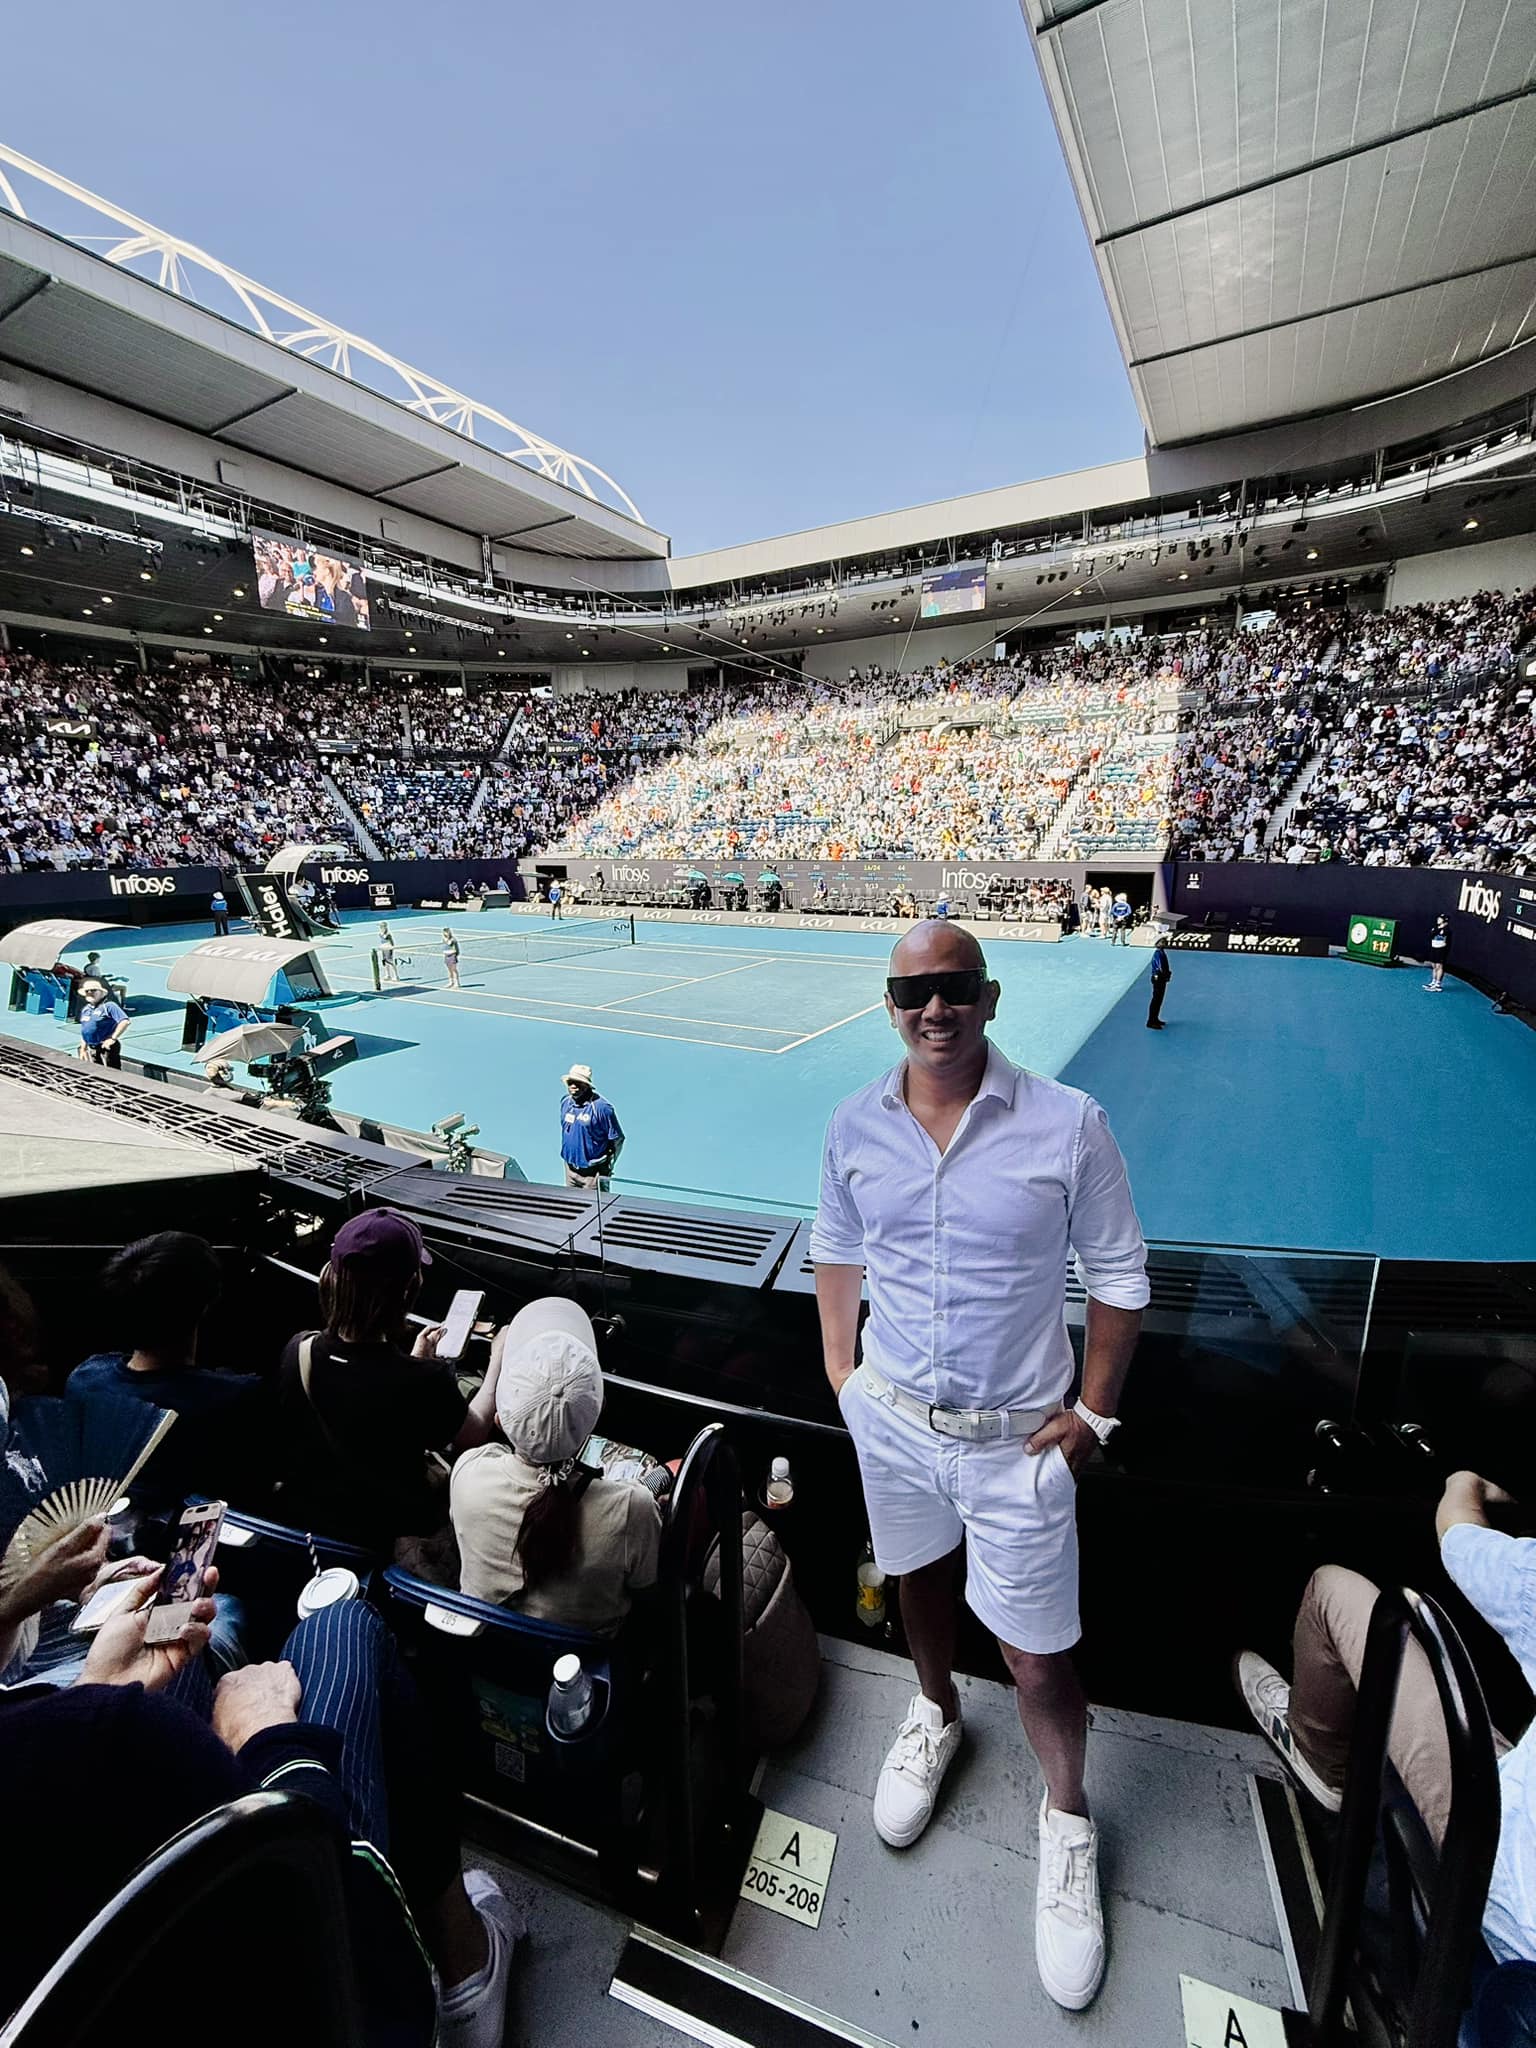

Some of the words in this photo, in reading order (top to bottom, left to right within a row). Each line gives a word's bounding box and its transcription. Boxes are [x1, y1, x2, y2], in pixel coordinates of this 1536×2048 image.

[320, 866, 370, 885] Infosys
[612, 864, 650, 884] Infosys
[109, 874, 176, 896] Infosys
[1458, 878, 1501, 923] Infosys
[258, 885, 292, 938] Haier
[692, 912, 721, 922] KIA
[743, 915, 775, 925] KIA
[799, 918, 833, 928] KIA
[860, 920, 898, 931] KIA
[998, 926, 1043, 938] KIA
[780, 1831, 801, 1867] A
[744, 1866, 820, 1914] 205-208
[1224, 2007, 1248, 2048] A
